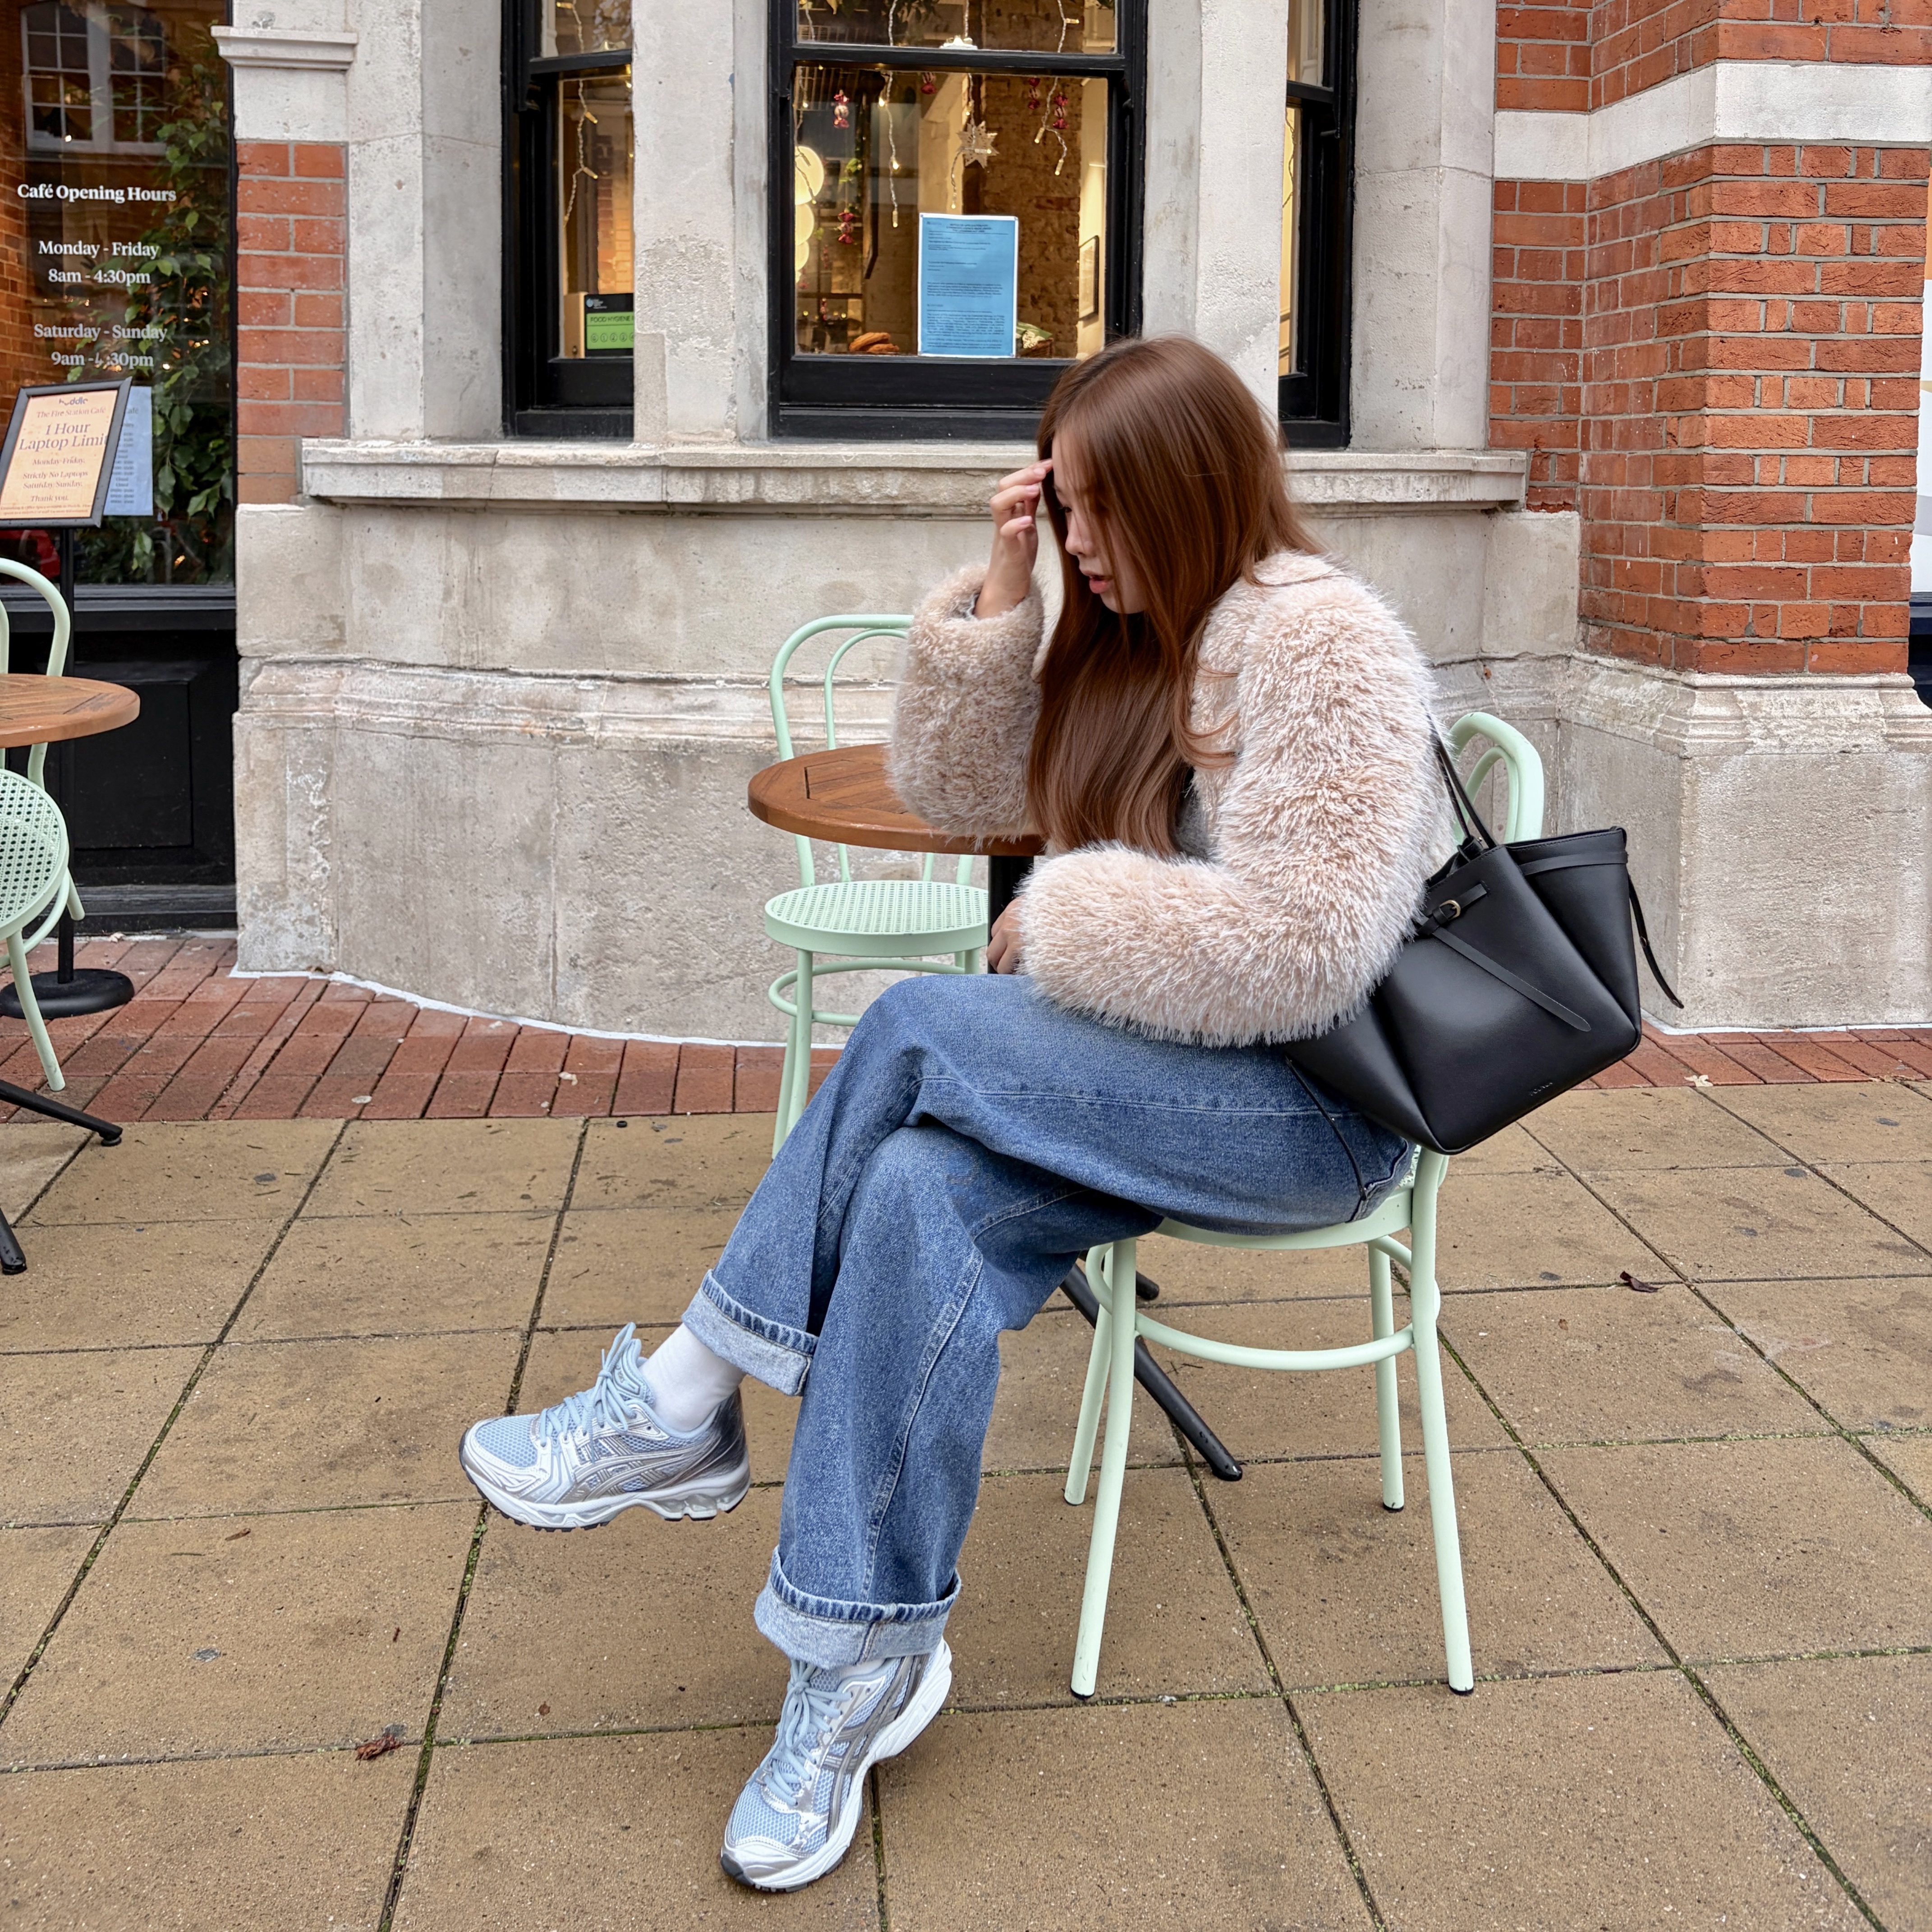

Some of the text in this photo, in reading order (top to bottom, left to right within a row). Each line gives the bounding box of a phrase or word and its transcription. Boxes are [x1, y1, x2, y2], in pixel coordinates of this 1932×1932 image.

[17, 184, 177, 203] Café Opening Hours
[38, 240, 100, 258] Monday
[112, 241, 160, 259] Friday
[48, 268, 82, 283] 8am
[94, 270, 151, 286] 4:30pm
[34, 323, 101, 341] Saturday
[112, 324, 167, 342] Sunday
[51, 351, 85, 366] 9am
[94, 352, 154, 369] 4:30pm
[65, 408, 89, 416] Station
[46, 423, 91, 435] 1 Hour
[18, 437, 69, 452] Laptop
